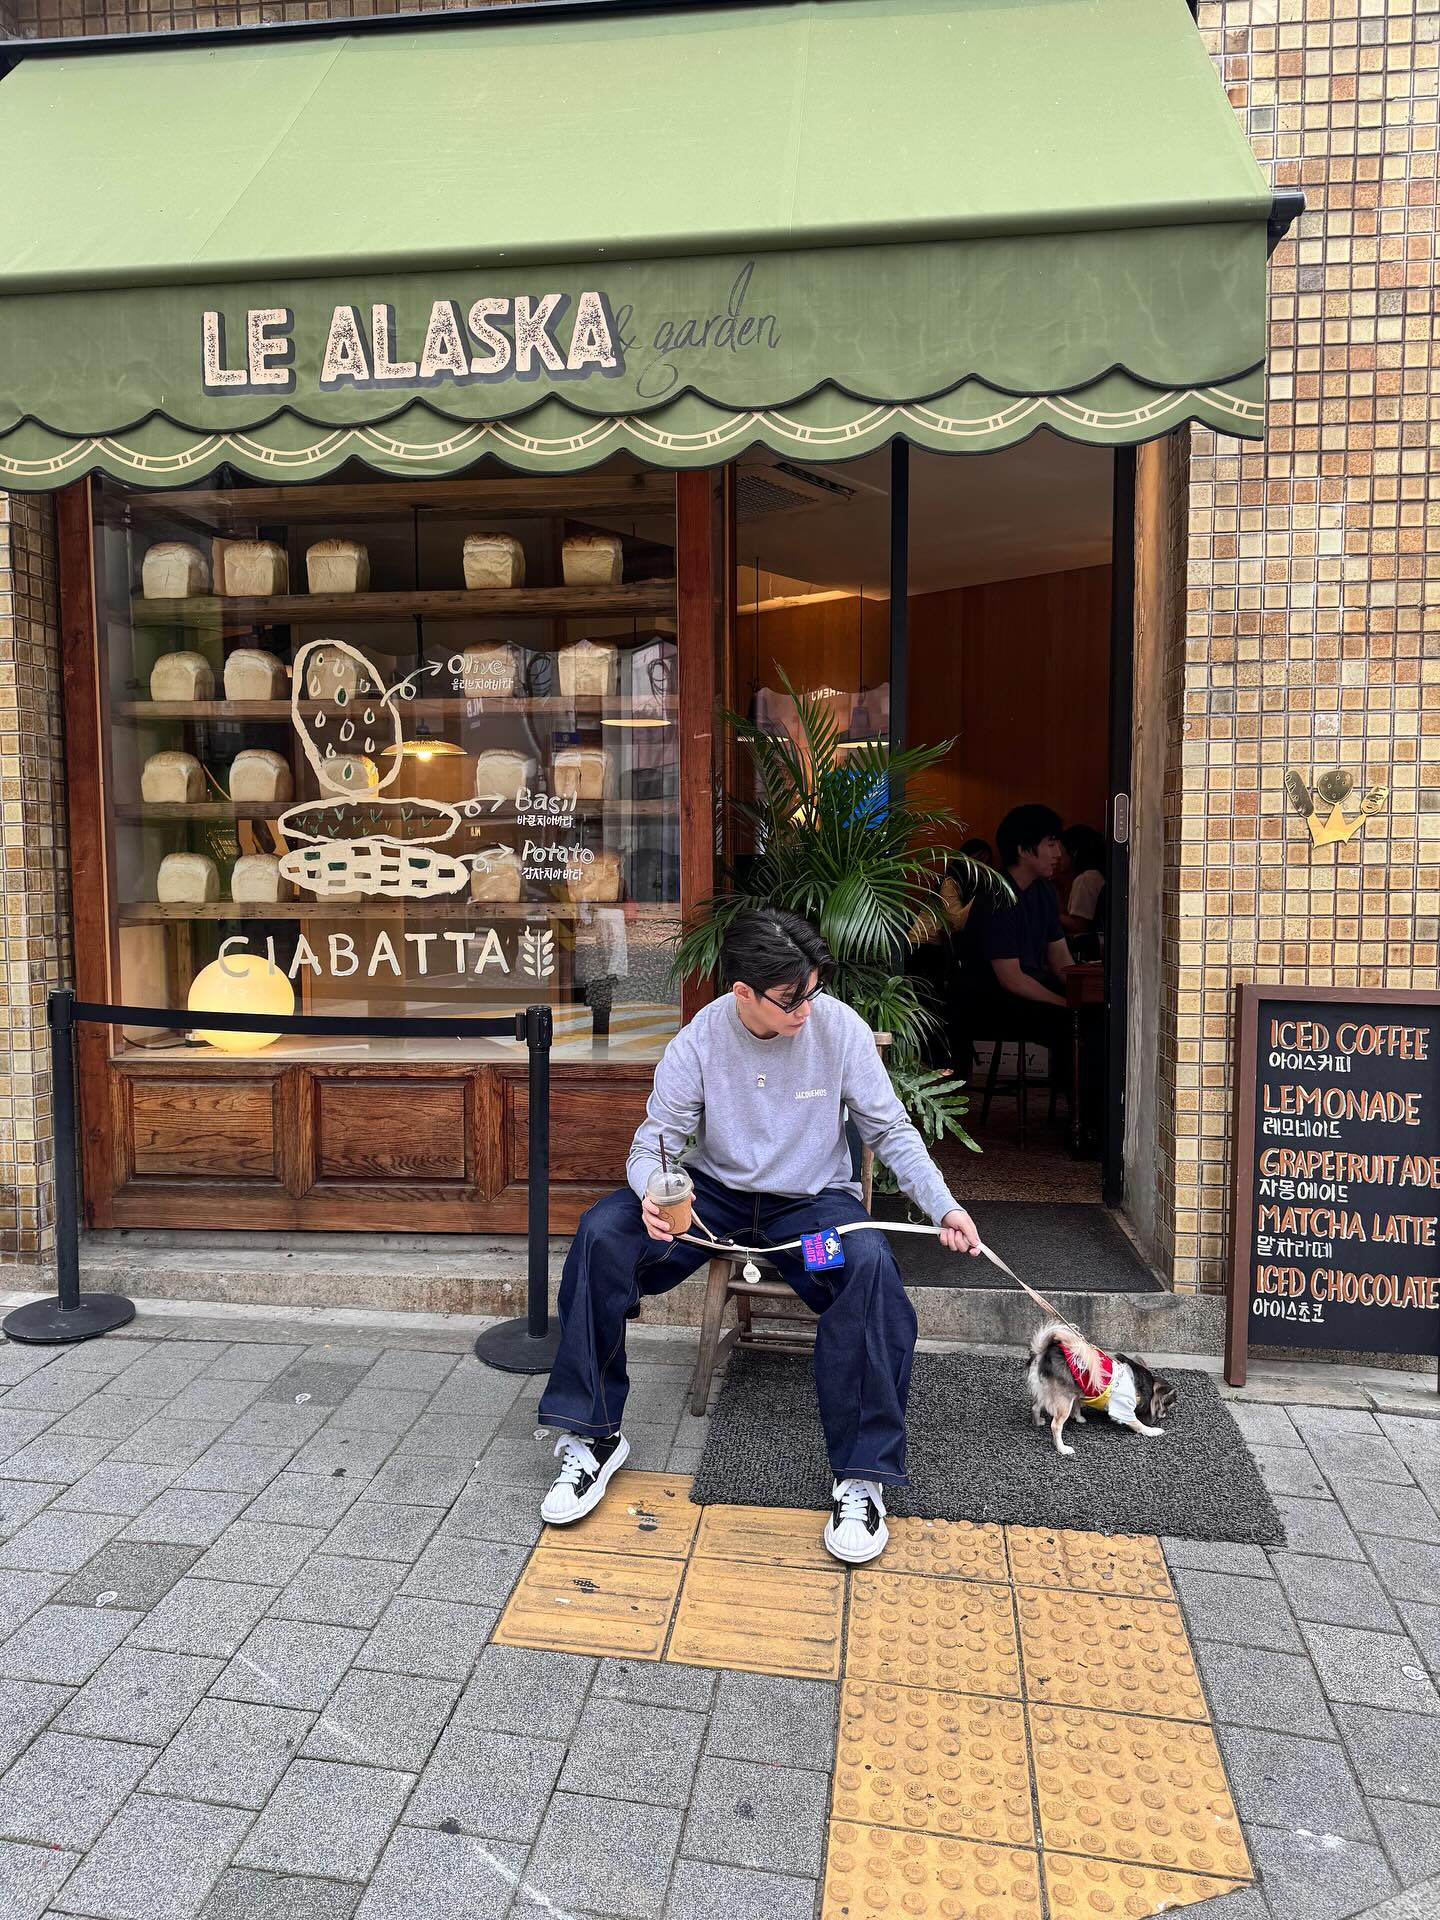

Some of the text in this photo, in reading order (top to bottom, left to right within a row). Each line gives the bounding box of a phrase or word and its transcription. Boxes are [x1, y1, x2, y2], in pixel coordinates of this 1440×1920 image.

[202, 307, 294, 393] LE
[319, 292, 623, 391] ALASKA
[636, 260, 782, 398] garden
[447, 654, 506, 676] Olive
[515, 786, 578, 815] Basil
[521, 839, 595, 865] Potato
[217, 928, 511, 980] CIABATTA
[1270, 1018, 1431, 1060] ICED COFFEE
[1268, 1051, 1351, 1073] 아이스커피
[1263, 1083, 1423, 1126] LEMONADE
[1262, 1116, 1342, 1139] 레모네이드
[1258, 1178, 1349, 1203] 자몽에이드
[1258, 1204, 1438, 1247] MATCHA LATTE
[1256, 1235, 1333, 1259] 말차라떼
[1256, 1264, 1440, 1310] ICED CHOCOLATE
[1252, 1298, 1325, 1323] 아이스초코
